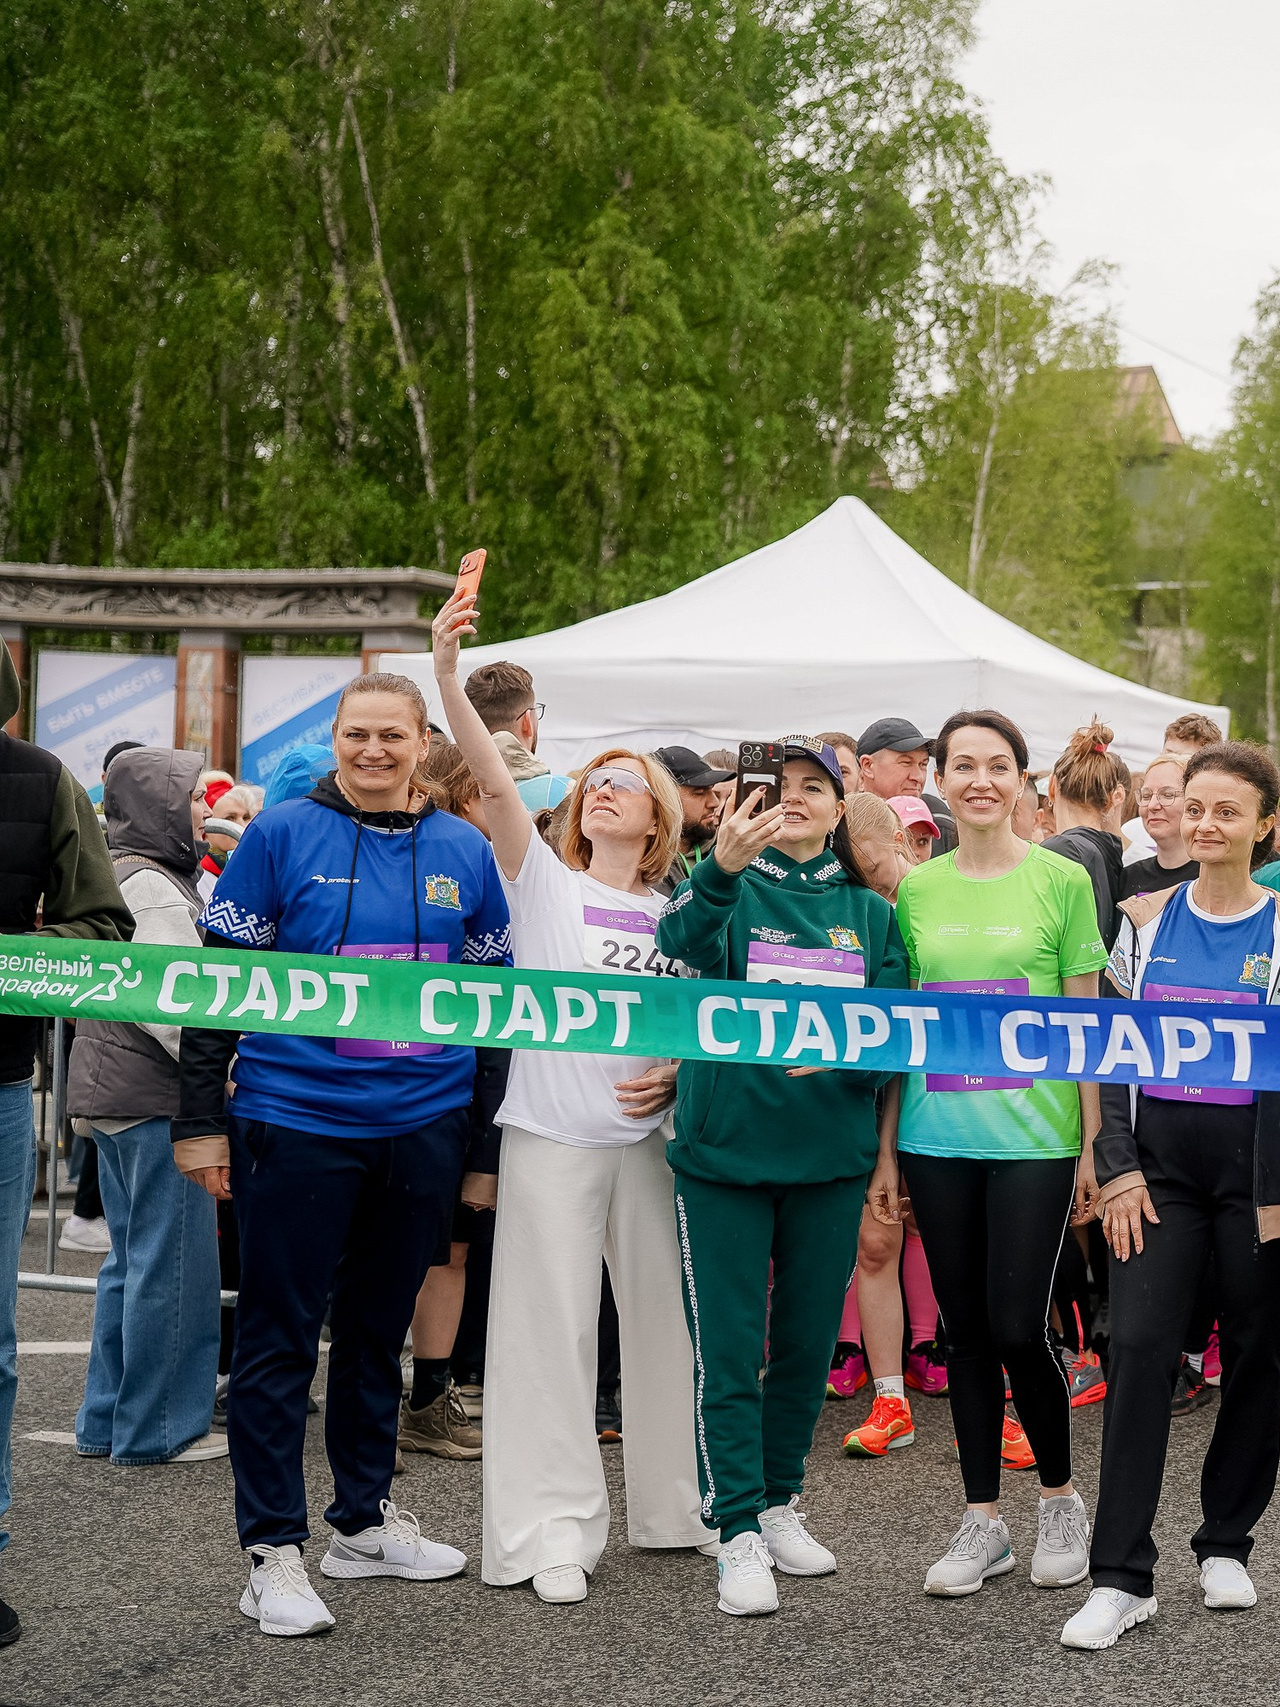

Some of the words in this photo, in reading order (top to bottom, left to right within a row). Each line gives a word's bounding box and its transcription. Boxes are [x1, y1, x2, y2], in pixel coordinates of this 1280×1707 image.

[95, 665, 165, 710] ВМЕСТЕ
[156, 960, 370, 1027] СТАРТ
[419, 978, 642, 1047] СТАРТ
[697, 996, 940, 1067] СТАРТ
[1000, 1010, 1266, 1082] СТАРТ
